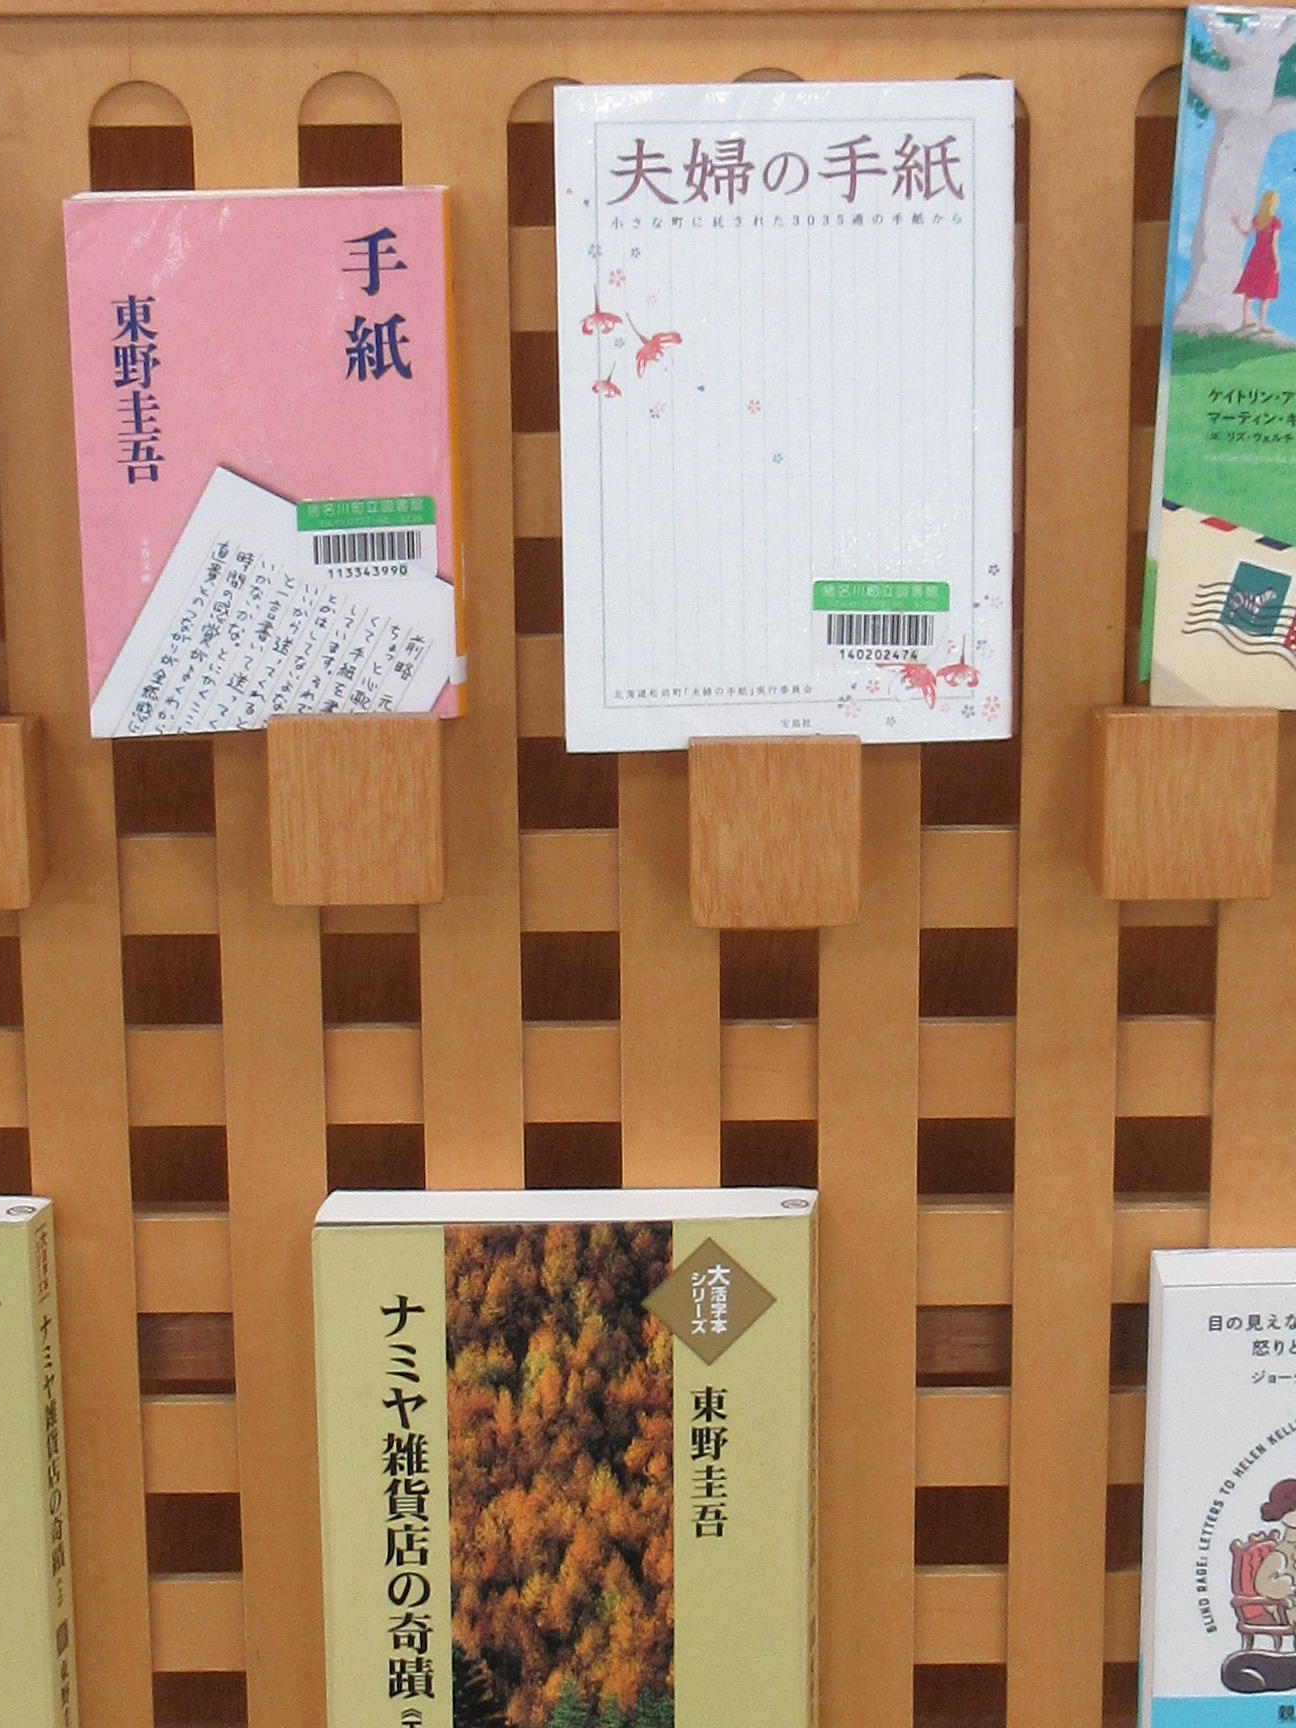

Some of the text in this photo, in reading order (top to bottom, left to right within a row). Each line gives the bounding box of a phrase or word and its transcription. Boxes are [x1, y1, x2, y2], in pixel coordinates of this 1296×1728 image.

[606, 132, 965, 206] 夫婦の手紙
[342, 227, 413, 382] 手紙
[110, 294, 165, 485] 東野圭吾
[327, 563, 408, 579] 113343990
[839, 649, 918, 660] 140202474
[690, 1272, 707, 1335] シリーズ
[707, 1264, 731, 1335] 大活字本
[689, 1385, 729, 1540] 東野圭吾
[1219, 1479, 1236, 1496] TO
[1232, 1442, 1267, 1479] HELEN
[1198, 1499, 1224, 1551] LETTERS
[1197, 1598, 1218, 1634] BLIND
